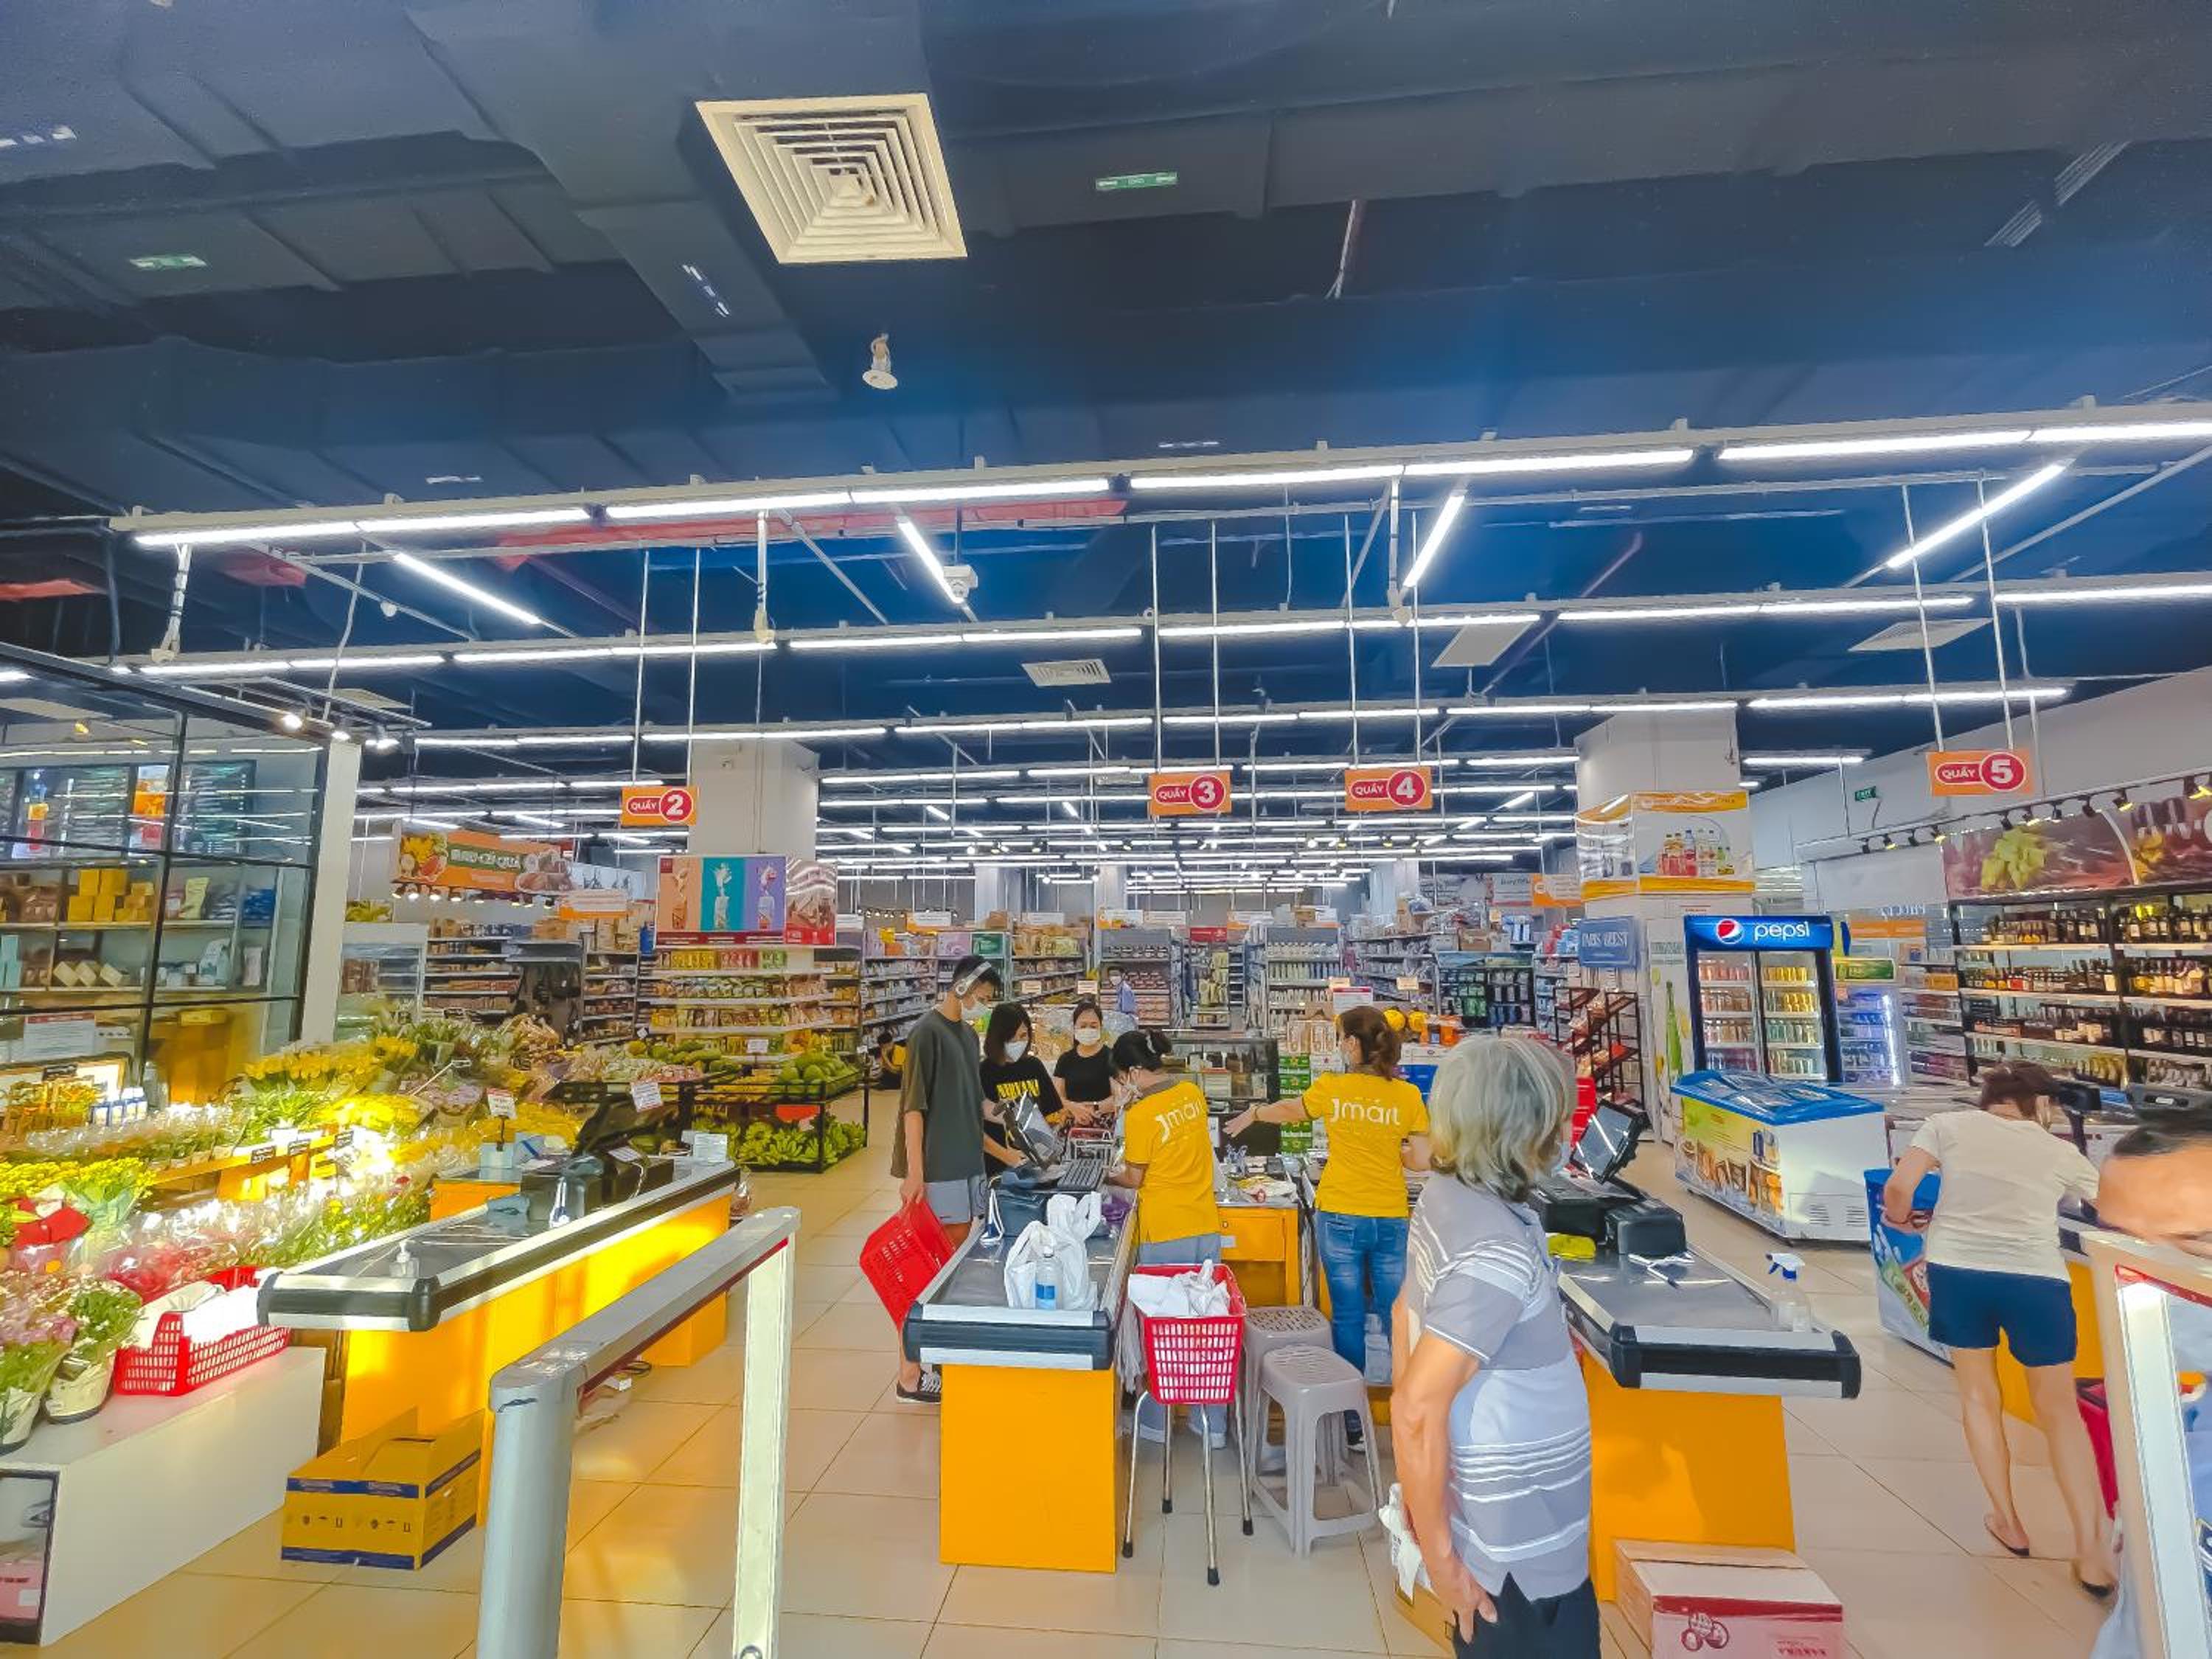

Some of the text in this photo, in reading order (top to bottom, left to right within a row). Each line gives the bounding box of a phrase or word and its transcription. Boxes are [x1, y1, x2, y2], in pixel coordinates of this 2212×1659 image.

[1991, 759, 2014, 784] 5
[1198, 781, 1216, 803] 3
[1396, 776, 1416, 799] 4
[666, 794, 684, 815] 2
[1754, 921, 1810, 941] pepsi
[1329, 1097, 1401, 1125] Jmart
